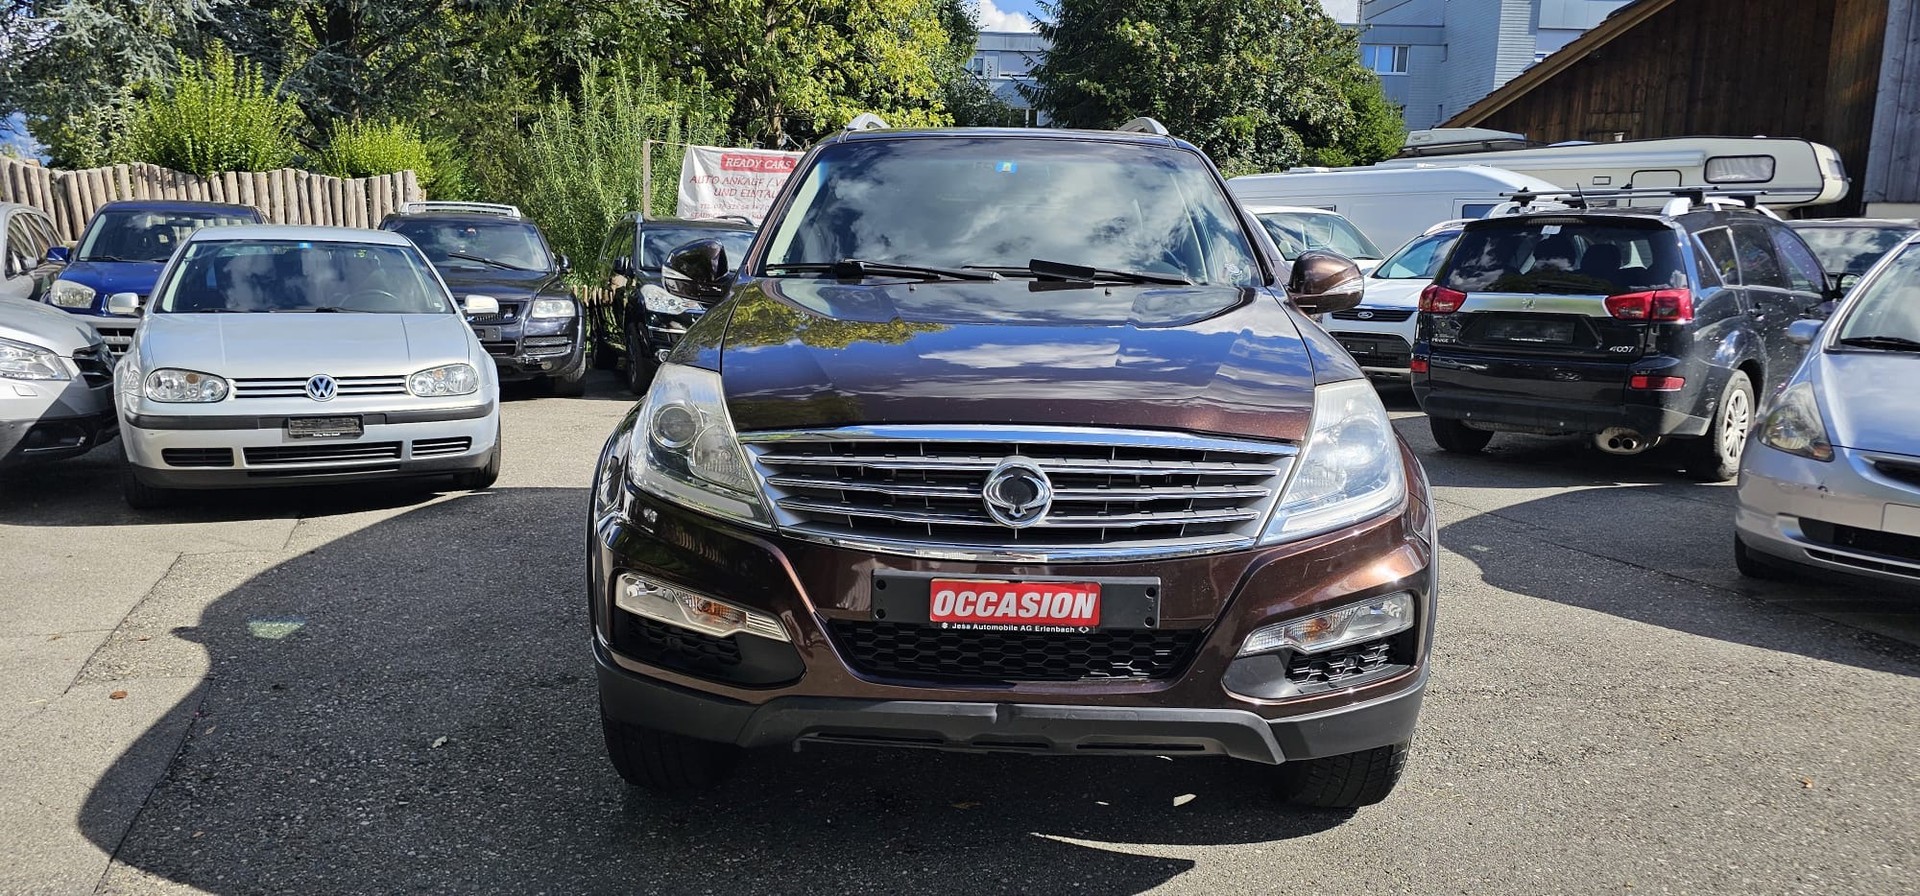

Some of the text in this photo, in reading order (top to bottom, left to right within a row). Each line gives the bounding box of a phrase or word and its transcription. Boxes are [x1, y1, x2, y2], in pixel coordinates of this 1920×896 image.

[725, 158, 792, 170] READY CARS
[690, 175, 719, 185] AUTO
[714, 188, 737, 197] UND
[1609, 345, 1635, 353] 4007
[932, 590, 1097, 619] OCCASION
[972, 623, 1018, 631] Automobile
[1035, 625, 1075, 633] Erlenbach
